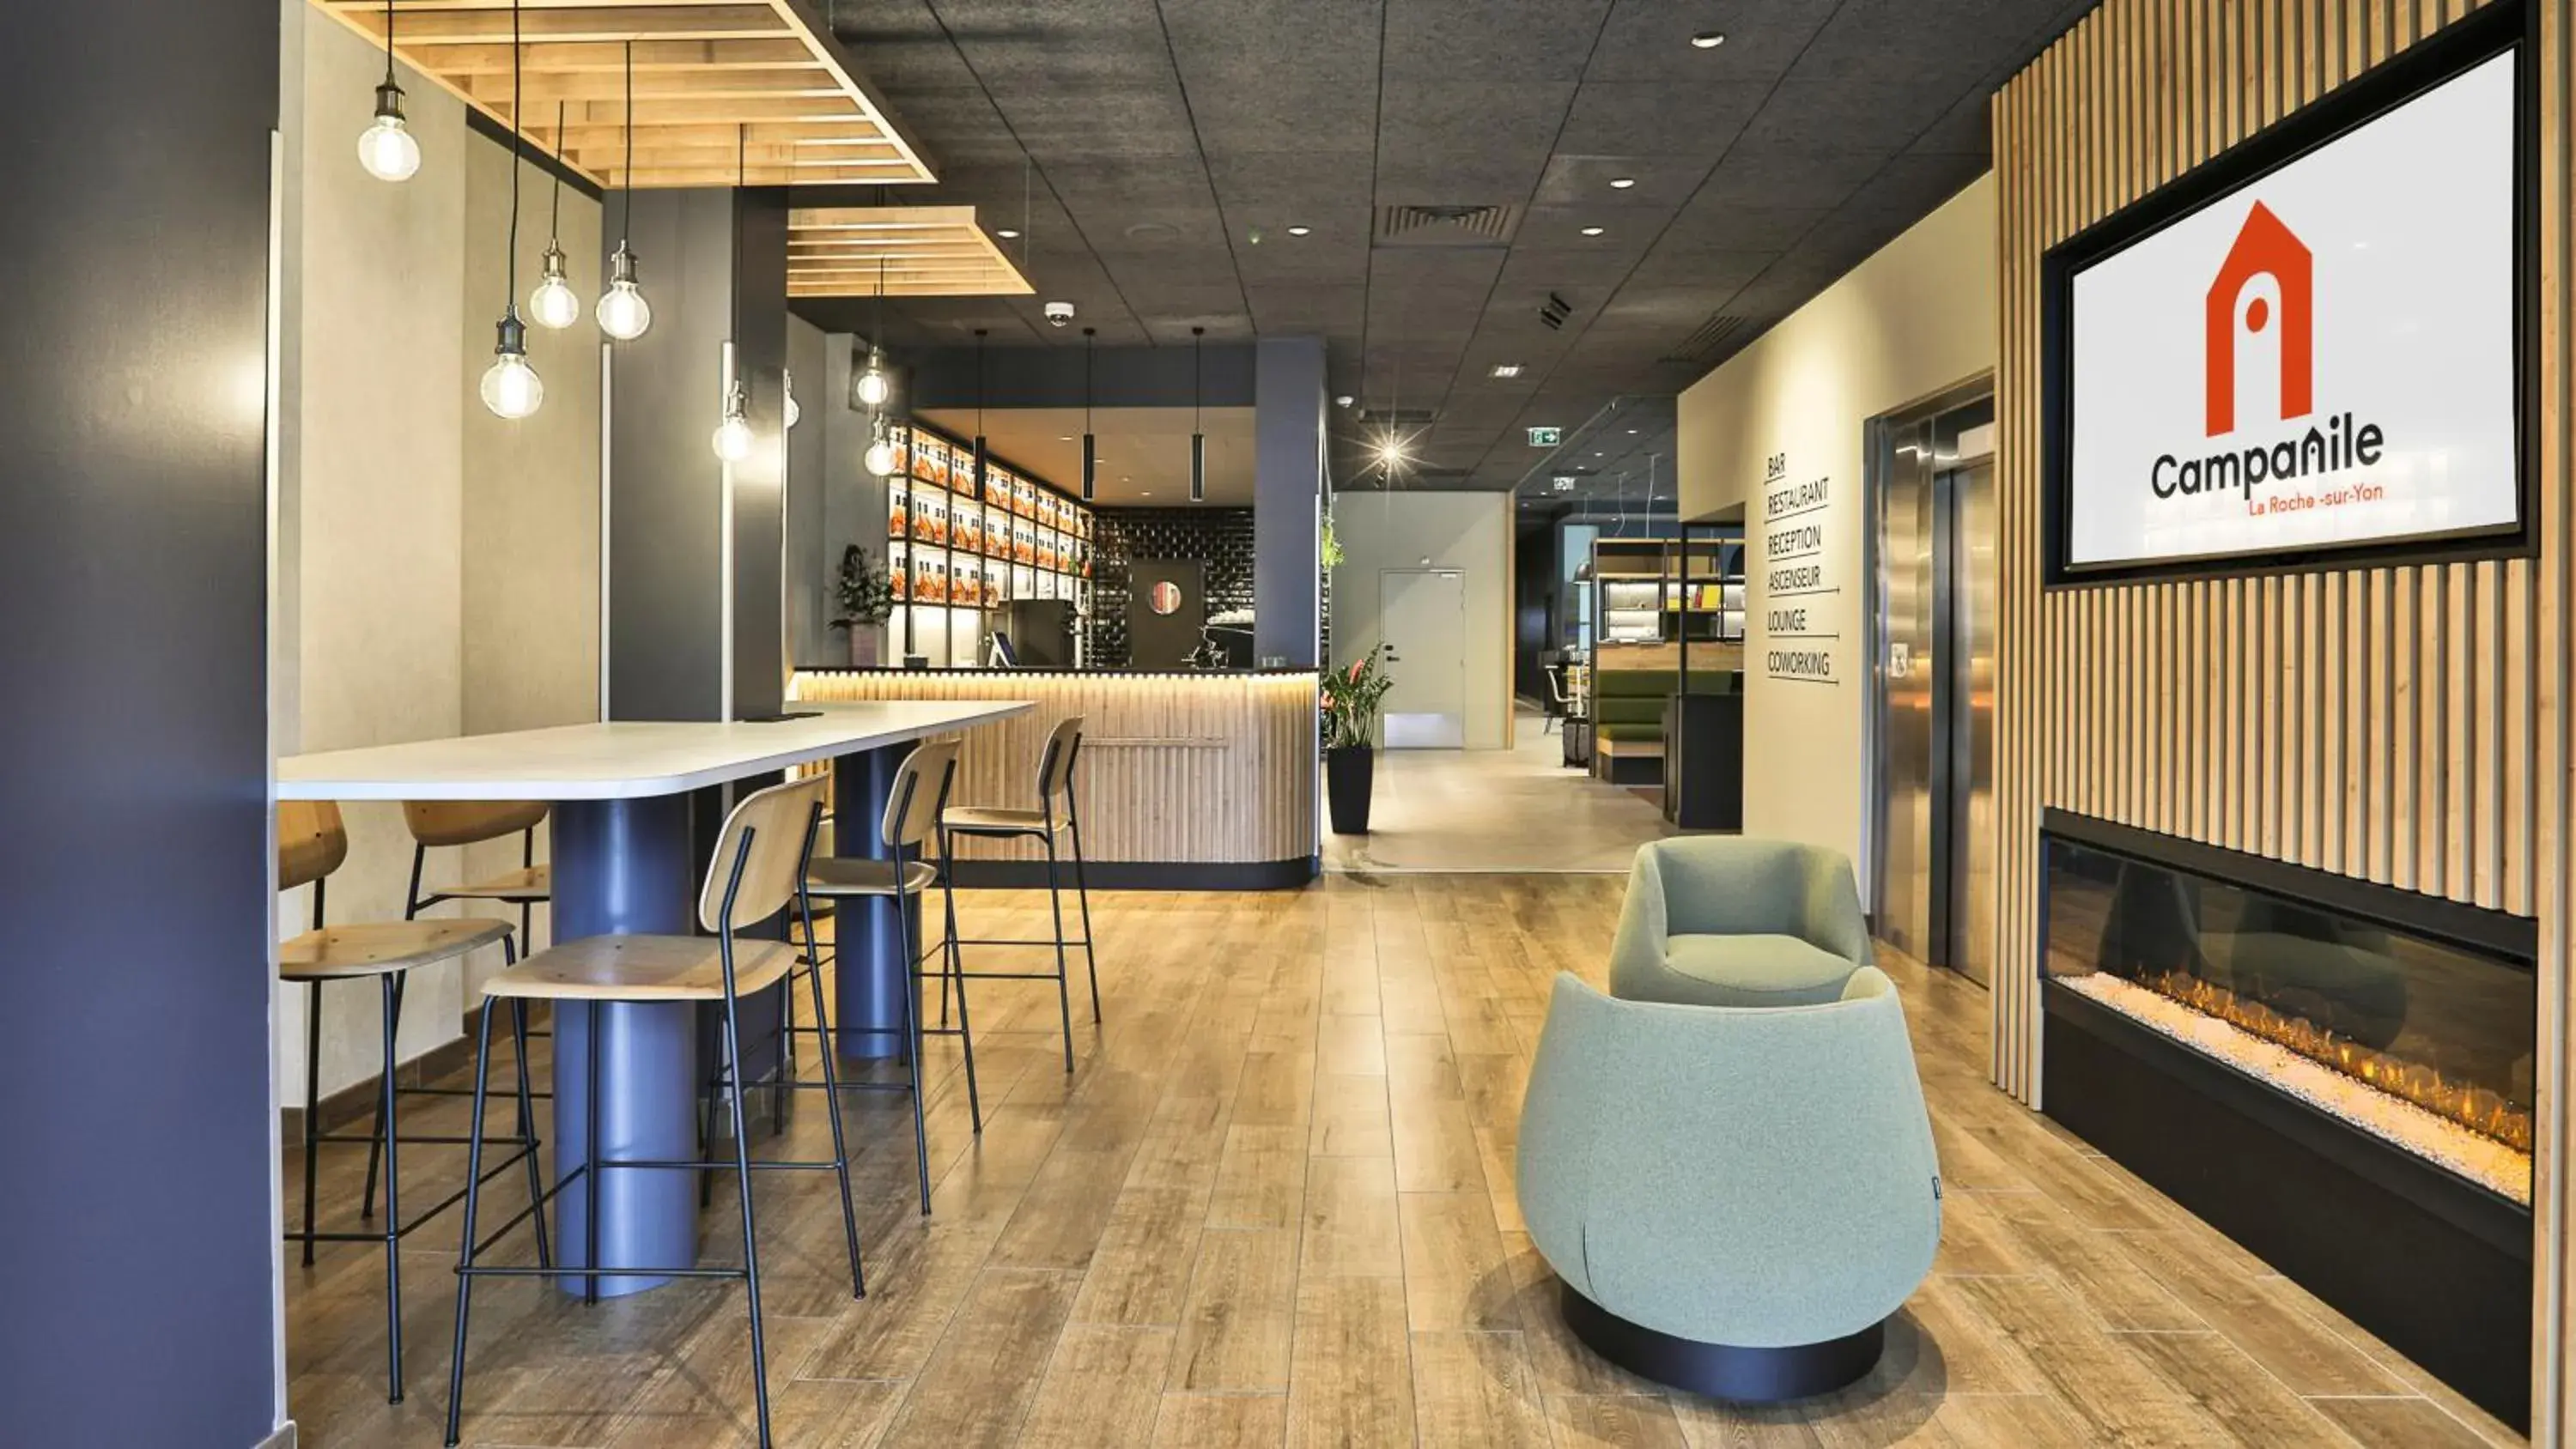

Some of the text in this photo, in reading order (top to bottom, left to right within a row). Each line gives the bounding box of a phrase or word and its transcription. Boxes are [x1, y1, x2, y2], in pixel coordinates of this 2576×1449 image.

[1768, 452, 1786, 477] BAR
[2152, 411, 2385, 500] Campanile
[1768, 476, 1829, 515] RESTAURANT
[2249, 500, 2265, 517] La
[2269, 492, 2315, 514] Roche
[1768, 524, 1821, 555] RECEPTION
[1769, 565, 1821, 591] ASCENSEUR
[1768, 609, 1806, 631] LOUNGE
[1768, 651, 1830, 676] COWORKING
